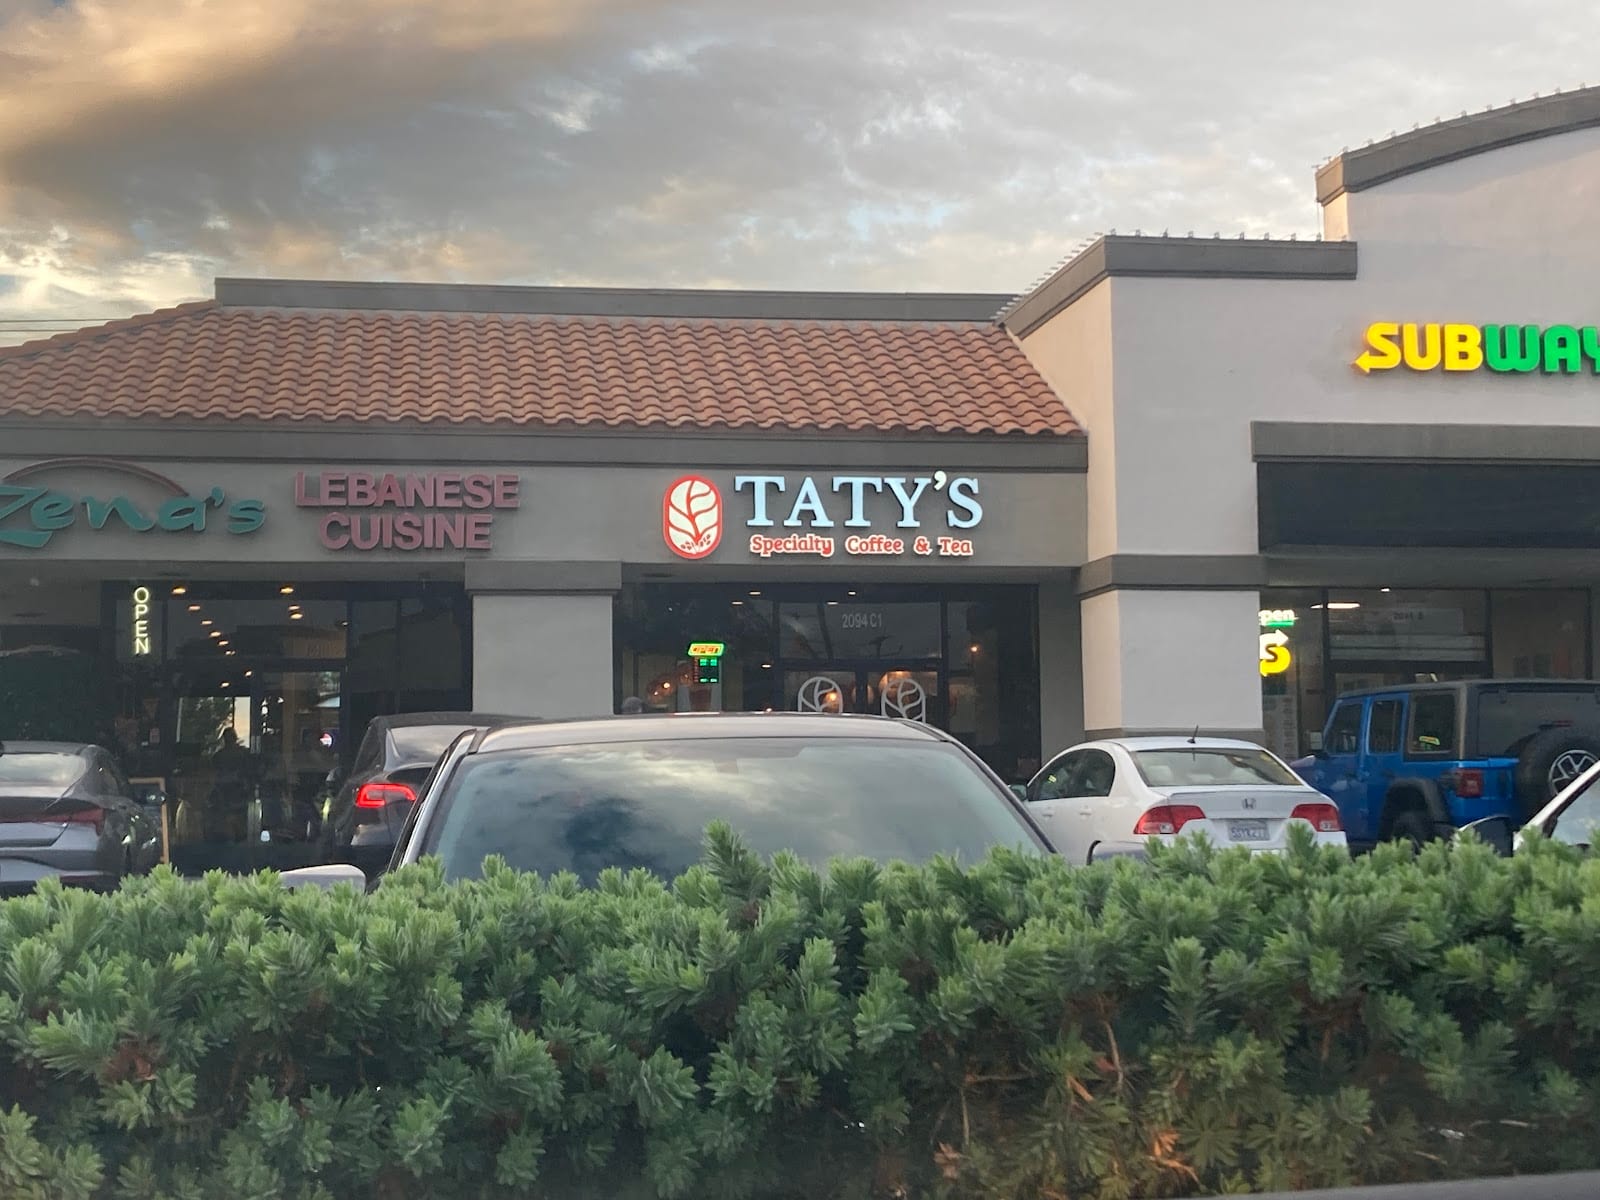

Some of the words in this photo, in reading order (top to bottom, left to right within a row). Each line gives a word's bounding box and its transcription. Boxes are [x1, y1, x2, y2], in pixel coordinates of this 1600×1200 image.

[295, 471, 520, 509] LEBANESE
[735, 470, 983, 529] TATY'S
[319, 511, 493, 550] CUISINE
[750, 533, 834, 557] Specialty
[845, 534, 904, 555] Coffee
[914, 535, 932, 555] &
[938, 536, 973, 556] Tea
[133, 586, 149, 654] OPEN
[842, 613, 868, 628] 2094
[1258, 609, 1296, 626] pen
